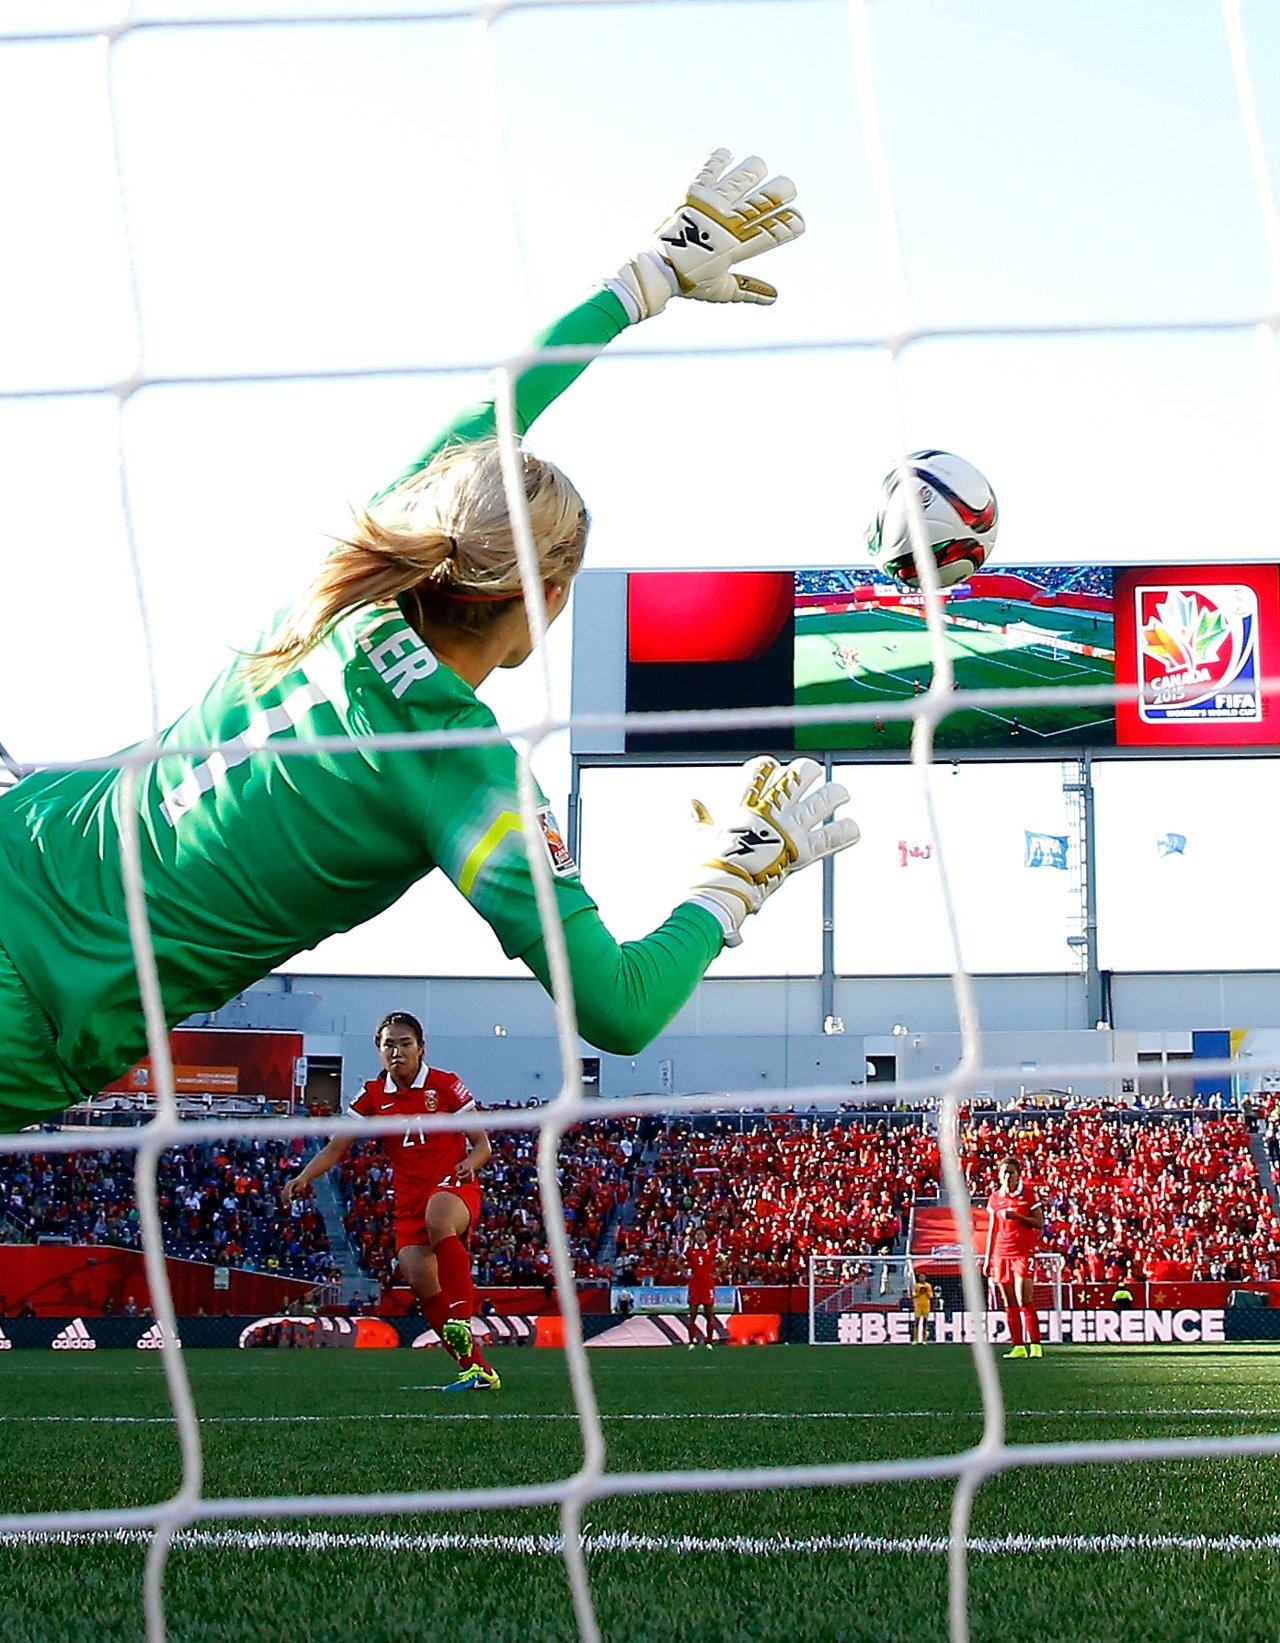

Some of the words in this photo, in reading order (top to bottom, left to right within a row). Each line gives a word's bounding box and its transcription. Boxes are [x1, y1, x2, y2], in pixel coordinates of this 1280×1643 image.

[1150, 668, 1211, 690] CANADA
[1153, 686, 1186, 705] 2015
[1214, 693, 1256, 709] FIFA
[51, 1338, 97, 1350] adidas
